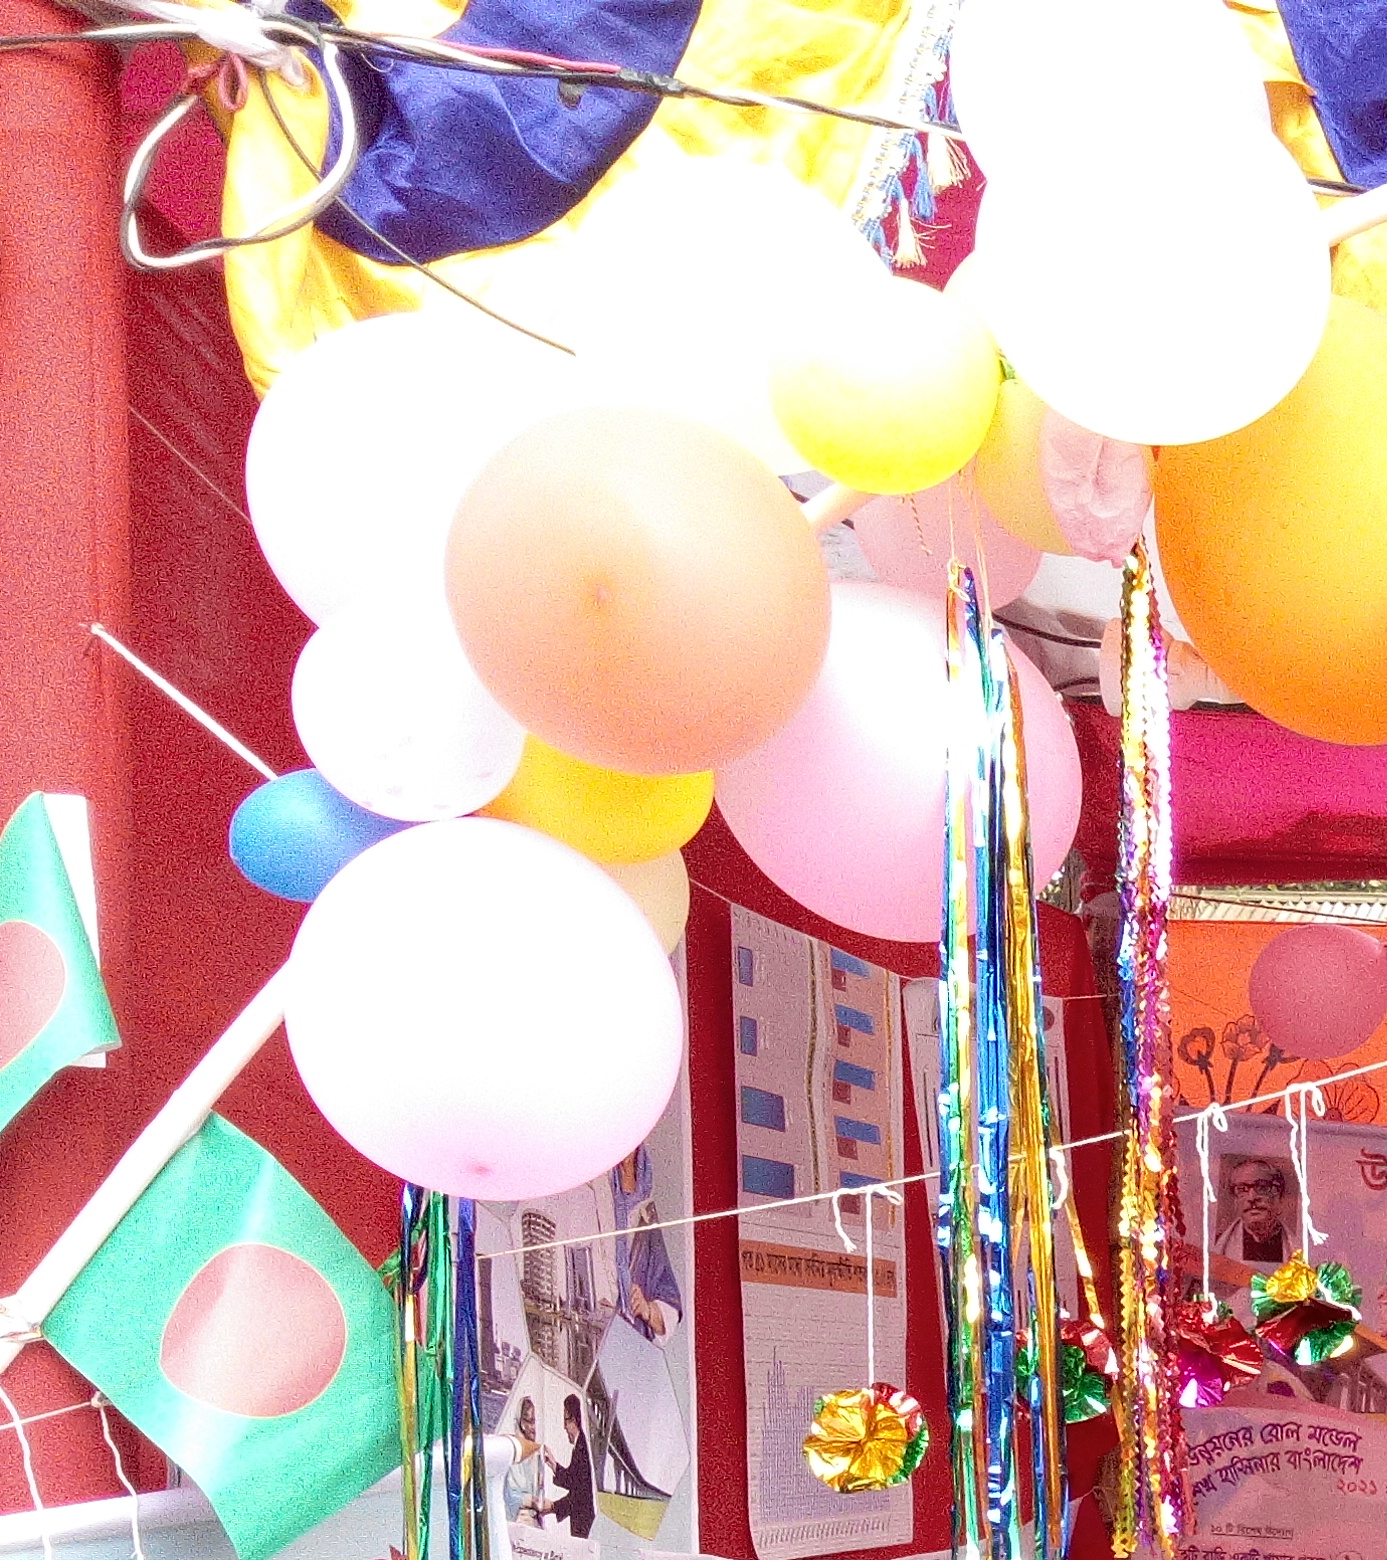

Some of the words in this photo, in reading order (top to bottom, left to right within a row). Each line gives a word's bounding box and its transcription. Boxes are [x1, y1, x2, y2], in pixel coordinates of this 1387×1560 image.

[1260, 1422, 1301, 1444] রোল
[1285, 1447, 1363, 1474] বাংলাদেশ
[1335, 1476, 1378, 1496] ২০২১
